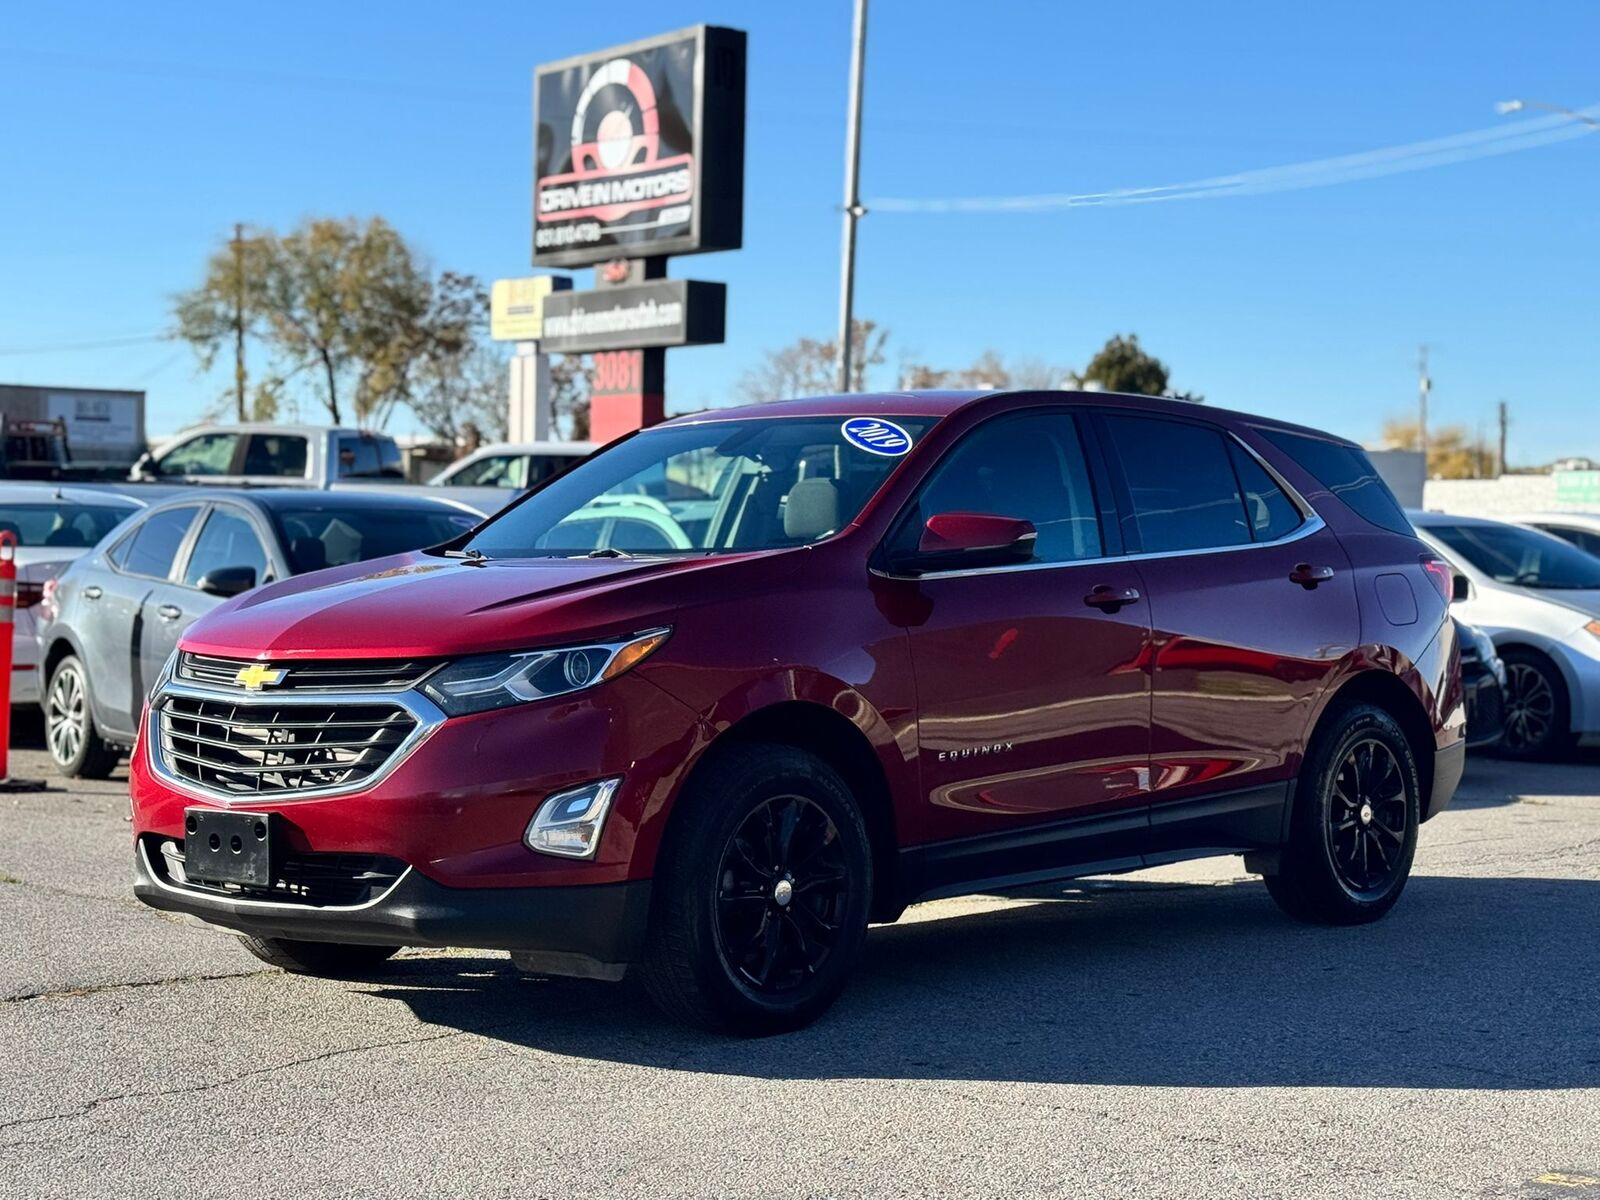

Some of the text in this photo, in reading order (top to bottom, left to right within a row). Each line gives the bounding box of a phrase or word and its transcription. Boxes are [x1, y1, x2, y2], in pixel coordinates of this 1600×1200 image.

[540, 169, 689, 212] DRIVEN MOTORS
[592, 351, 640, 390] 3081
[847, 422, 907, 447] 2019
[938, 742, 1013, 761] EQUINOX
